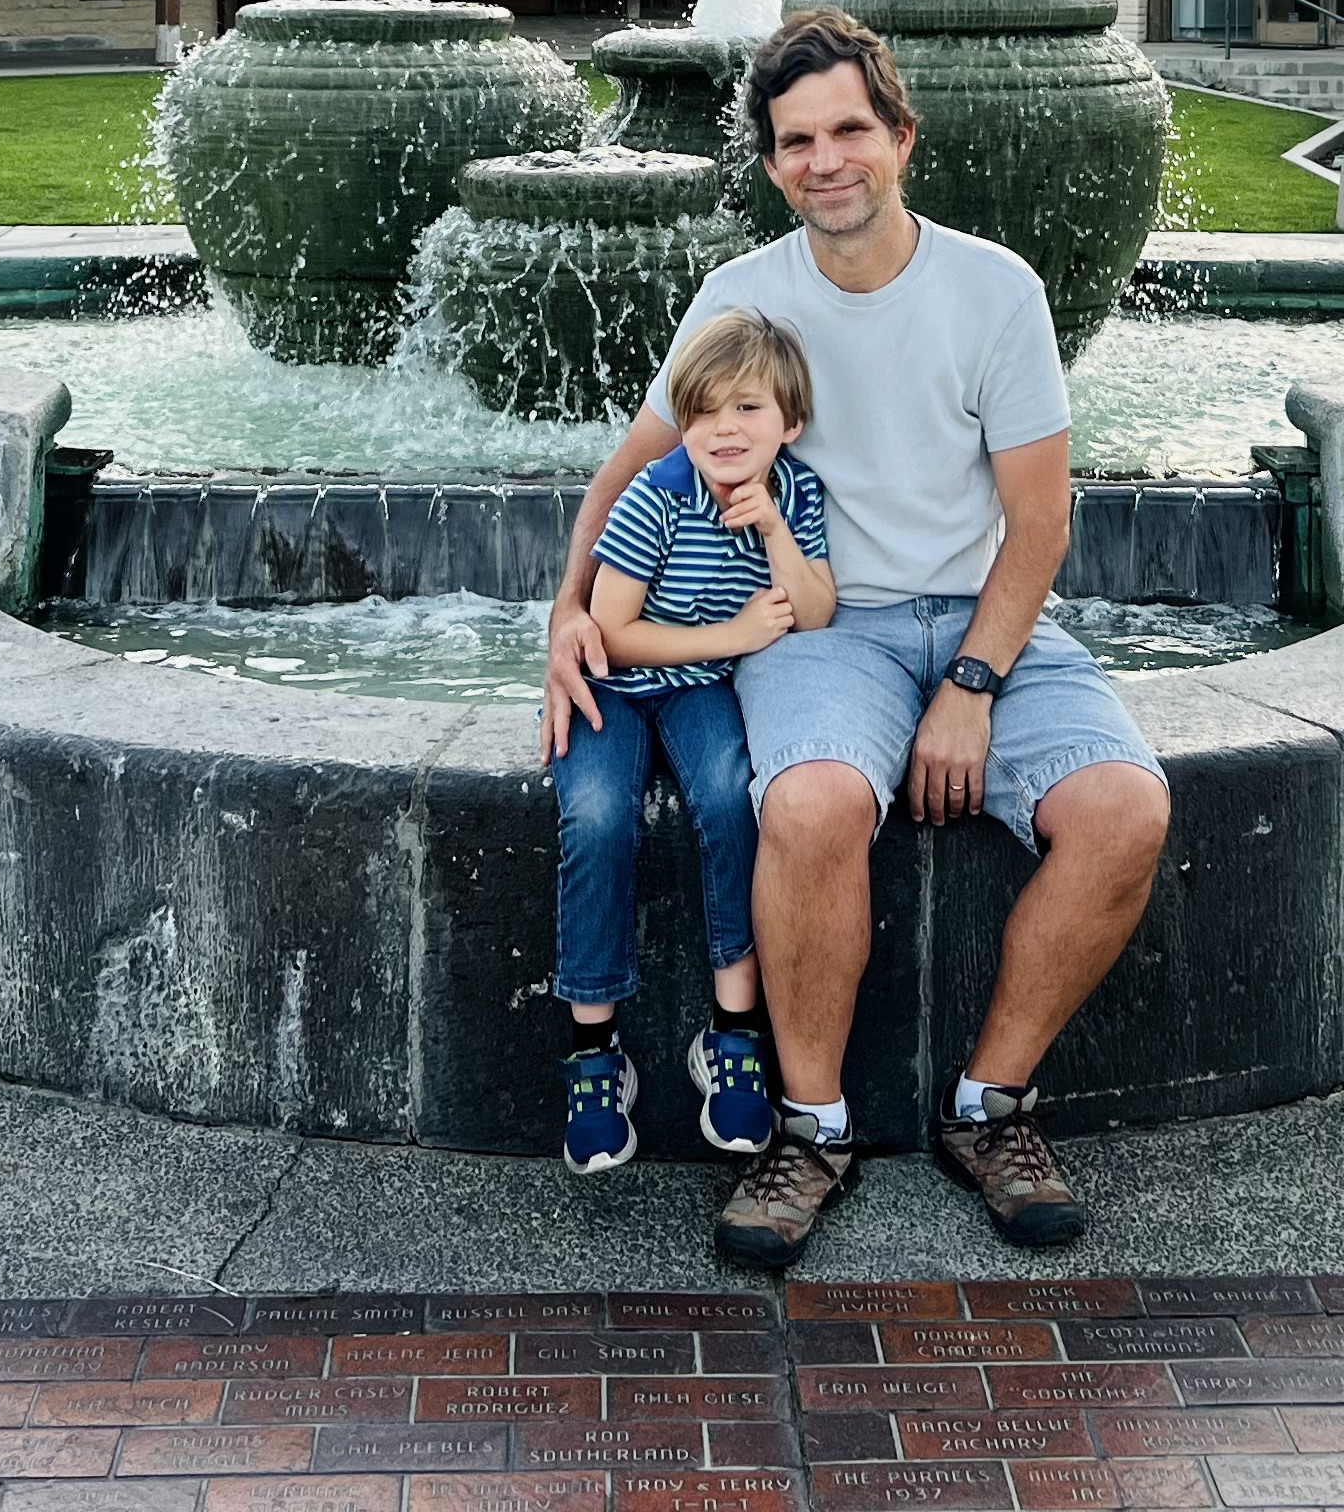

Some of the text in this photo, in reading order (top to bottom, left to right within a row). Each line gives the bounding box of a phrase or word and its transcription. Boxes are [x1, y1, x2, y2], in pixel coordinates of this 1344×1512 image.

[1028, 1286, 1076, 1297] DICK
[1148, 1291, 1197, 1302] OPAL
[116, 1304, 196, 1315] ROBERT
[622, 1305, 767, 1318] PAUL BESCOS
[840, 1302, 910, 1313] LYNCH
[1006, 1300, 1102, 1311] COLTRELL
[255, 1309, 414, 1321] PAULINE SMITH
[441, 1308, 529, 1320] RUSSELL
[114, 1318, 192, 1329] KESLER
[913, 1330, 990, 1342] NORMA
[1082, 1326, 1146, 1339] SCOTT
[201, 1343, 269, 1356] CINDY
[345, 1347, 494, 1360] ARLENE JEAN
[598, 1347, 666, 1359] SABEN
[917, 1345, 1024, 1357] CAMERON
[1105, 1341, 1205, 1354] SIMMONS
[174, 1360, 290, 1371] ANDERSON
[1061, 1371, 1098, 1383] THE
[818, 1383, 868, 1396] ERIN
[1182, 1377, 1252, 1390] LARRY
[334, 1387, 407, 1399] CASEY
[466, 1386, 552, 1398] ROBERT
[704, 1392, 765, 1405] GIESE
[446, 1402, 571, 1415] RODRIGUEZ
[905, 1421, 982, 1434] NANCY
[585, 1430, 630, 1442] RON
[331, 1441, 495, 1455] GAIL PEEBLES
[941, 1437, 1048, 1451] ZACHARY
[529, 1448, 689, 1464] SOUTHERLAND
[833, 1470, 991, 1485] THE PURNELS
[624, 1479, 792, 1492] TROY & TERRY
[885, 1488, 943, 1502] 1937
